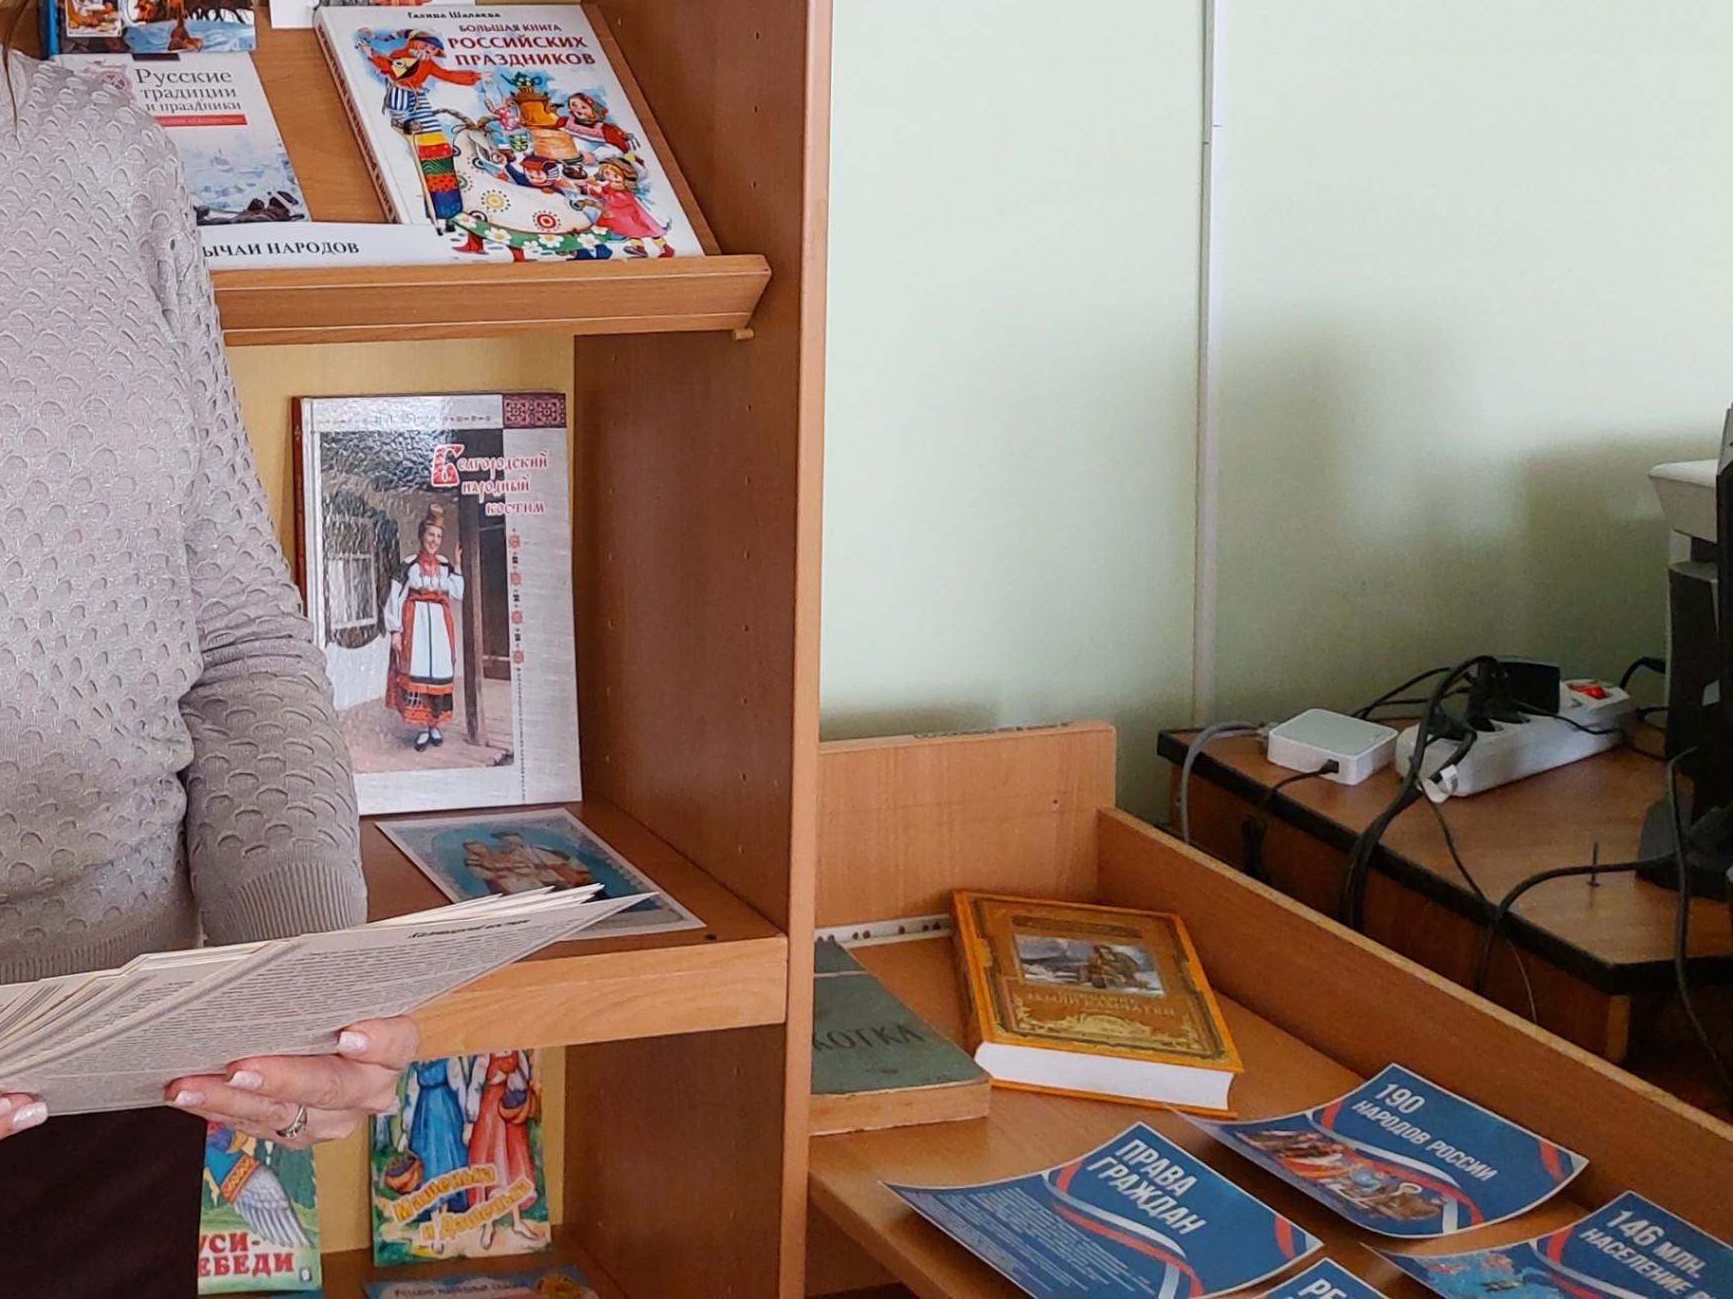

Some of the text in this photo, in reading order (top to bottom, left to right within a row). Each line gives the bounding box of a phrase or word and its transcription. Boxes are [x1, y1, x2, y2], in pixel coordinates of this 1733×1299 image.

[407, 11, 501, 19] Галина Шалаева
[459, 24, 562, 33] БОЛЬШАЯ КНИГА
[447, 34, 588, 49] РОССИЙСКИХ
[454, 53, 596, 67] ПРАЗДНИКОВ
[135, 68, 232, 87] Русские
[140, 88, 237, 102] традиции
[146, 103, 156, 111] и
[202, 241, 360, 258] ЫЧАИ НАРОДОВ
[1375, 1083, 1426, 1114] 190
[1351, 1100, 1499, 1181] НАРОДОВ РОССИИ
[1115, 1139, 1198, 1197] ПРАВА
[1086, 1156, 1207, 1235] ГРАЖДАН
[199, 1232, 260, 1254] СИ-
[1606, 1210, 1707, 1279] 146 МЛН.
[198, 1252, 294, 1277] ЕБЕДИ
[1579, 1227, 1694, 1294] НАСЕЛЕНИЕ
